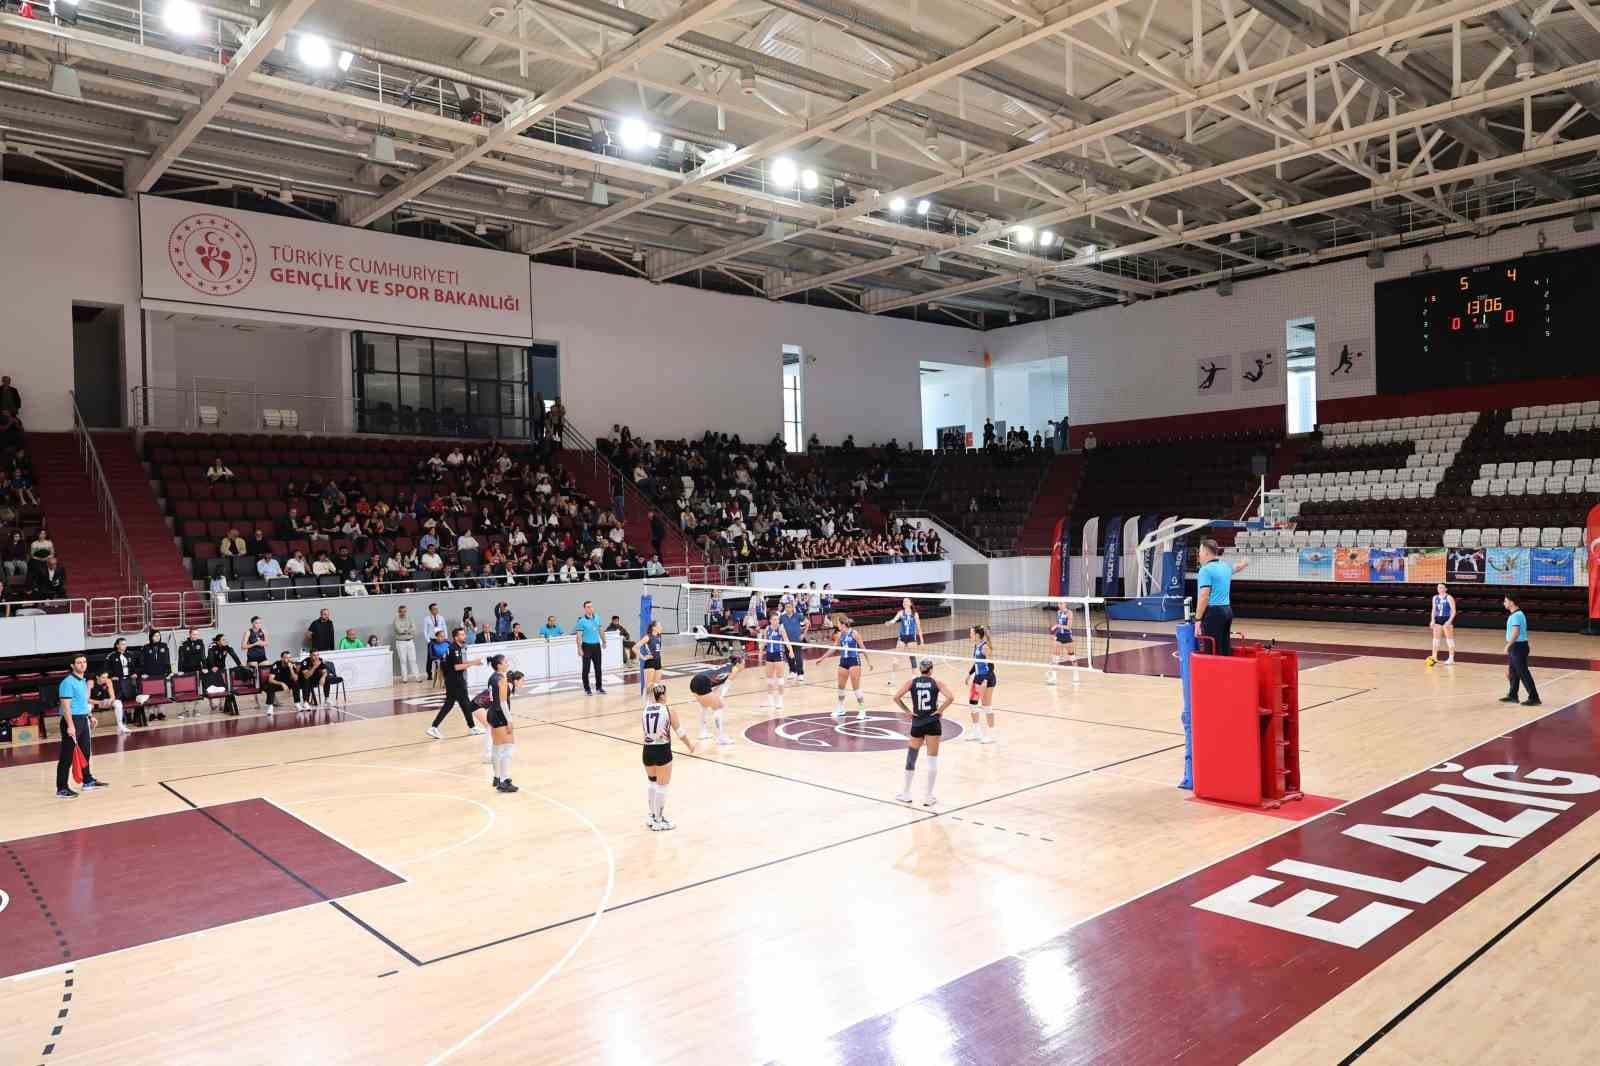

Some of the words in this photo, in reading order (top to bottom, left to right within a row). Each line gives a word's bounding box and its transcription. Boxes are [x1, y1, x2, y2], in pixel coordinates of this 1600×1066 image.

[270, 245, 343, 270] TÜRKİYE
[349, 257, 459, 286] CUMHURİYETİ
[1507, 268, 1516, 282] 4
[270, 267, 352, 292] GENÇLİK
[355, 279, 379, 294] VE
[384, 282, 429, 301] SPOR
[434, 288, 519, 312] BAKANLIĞI
[1460, 276, 1469, 291] 5
[1452, 317, 1461, 330] 0
[1505, 309, 1515, 323] 0
[916, 689, 932, 711] 12
[646, 713, 660, 734] 17
[1191, 762, 1600, 949] ELAZIĞ
